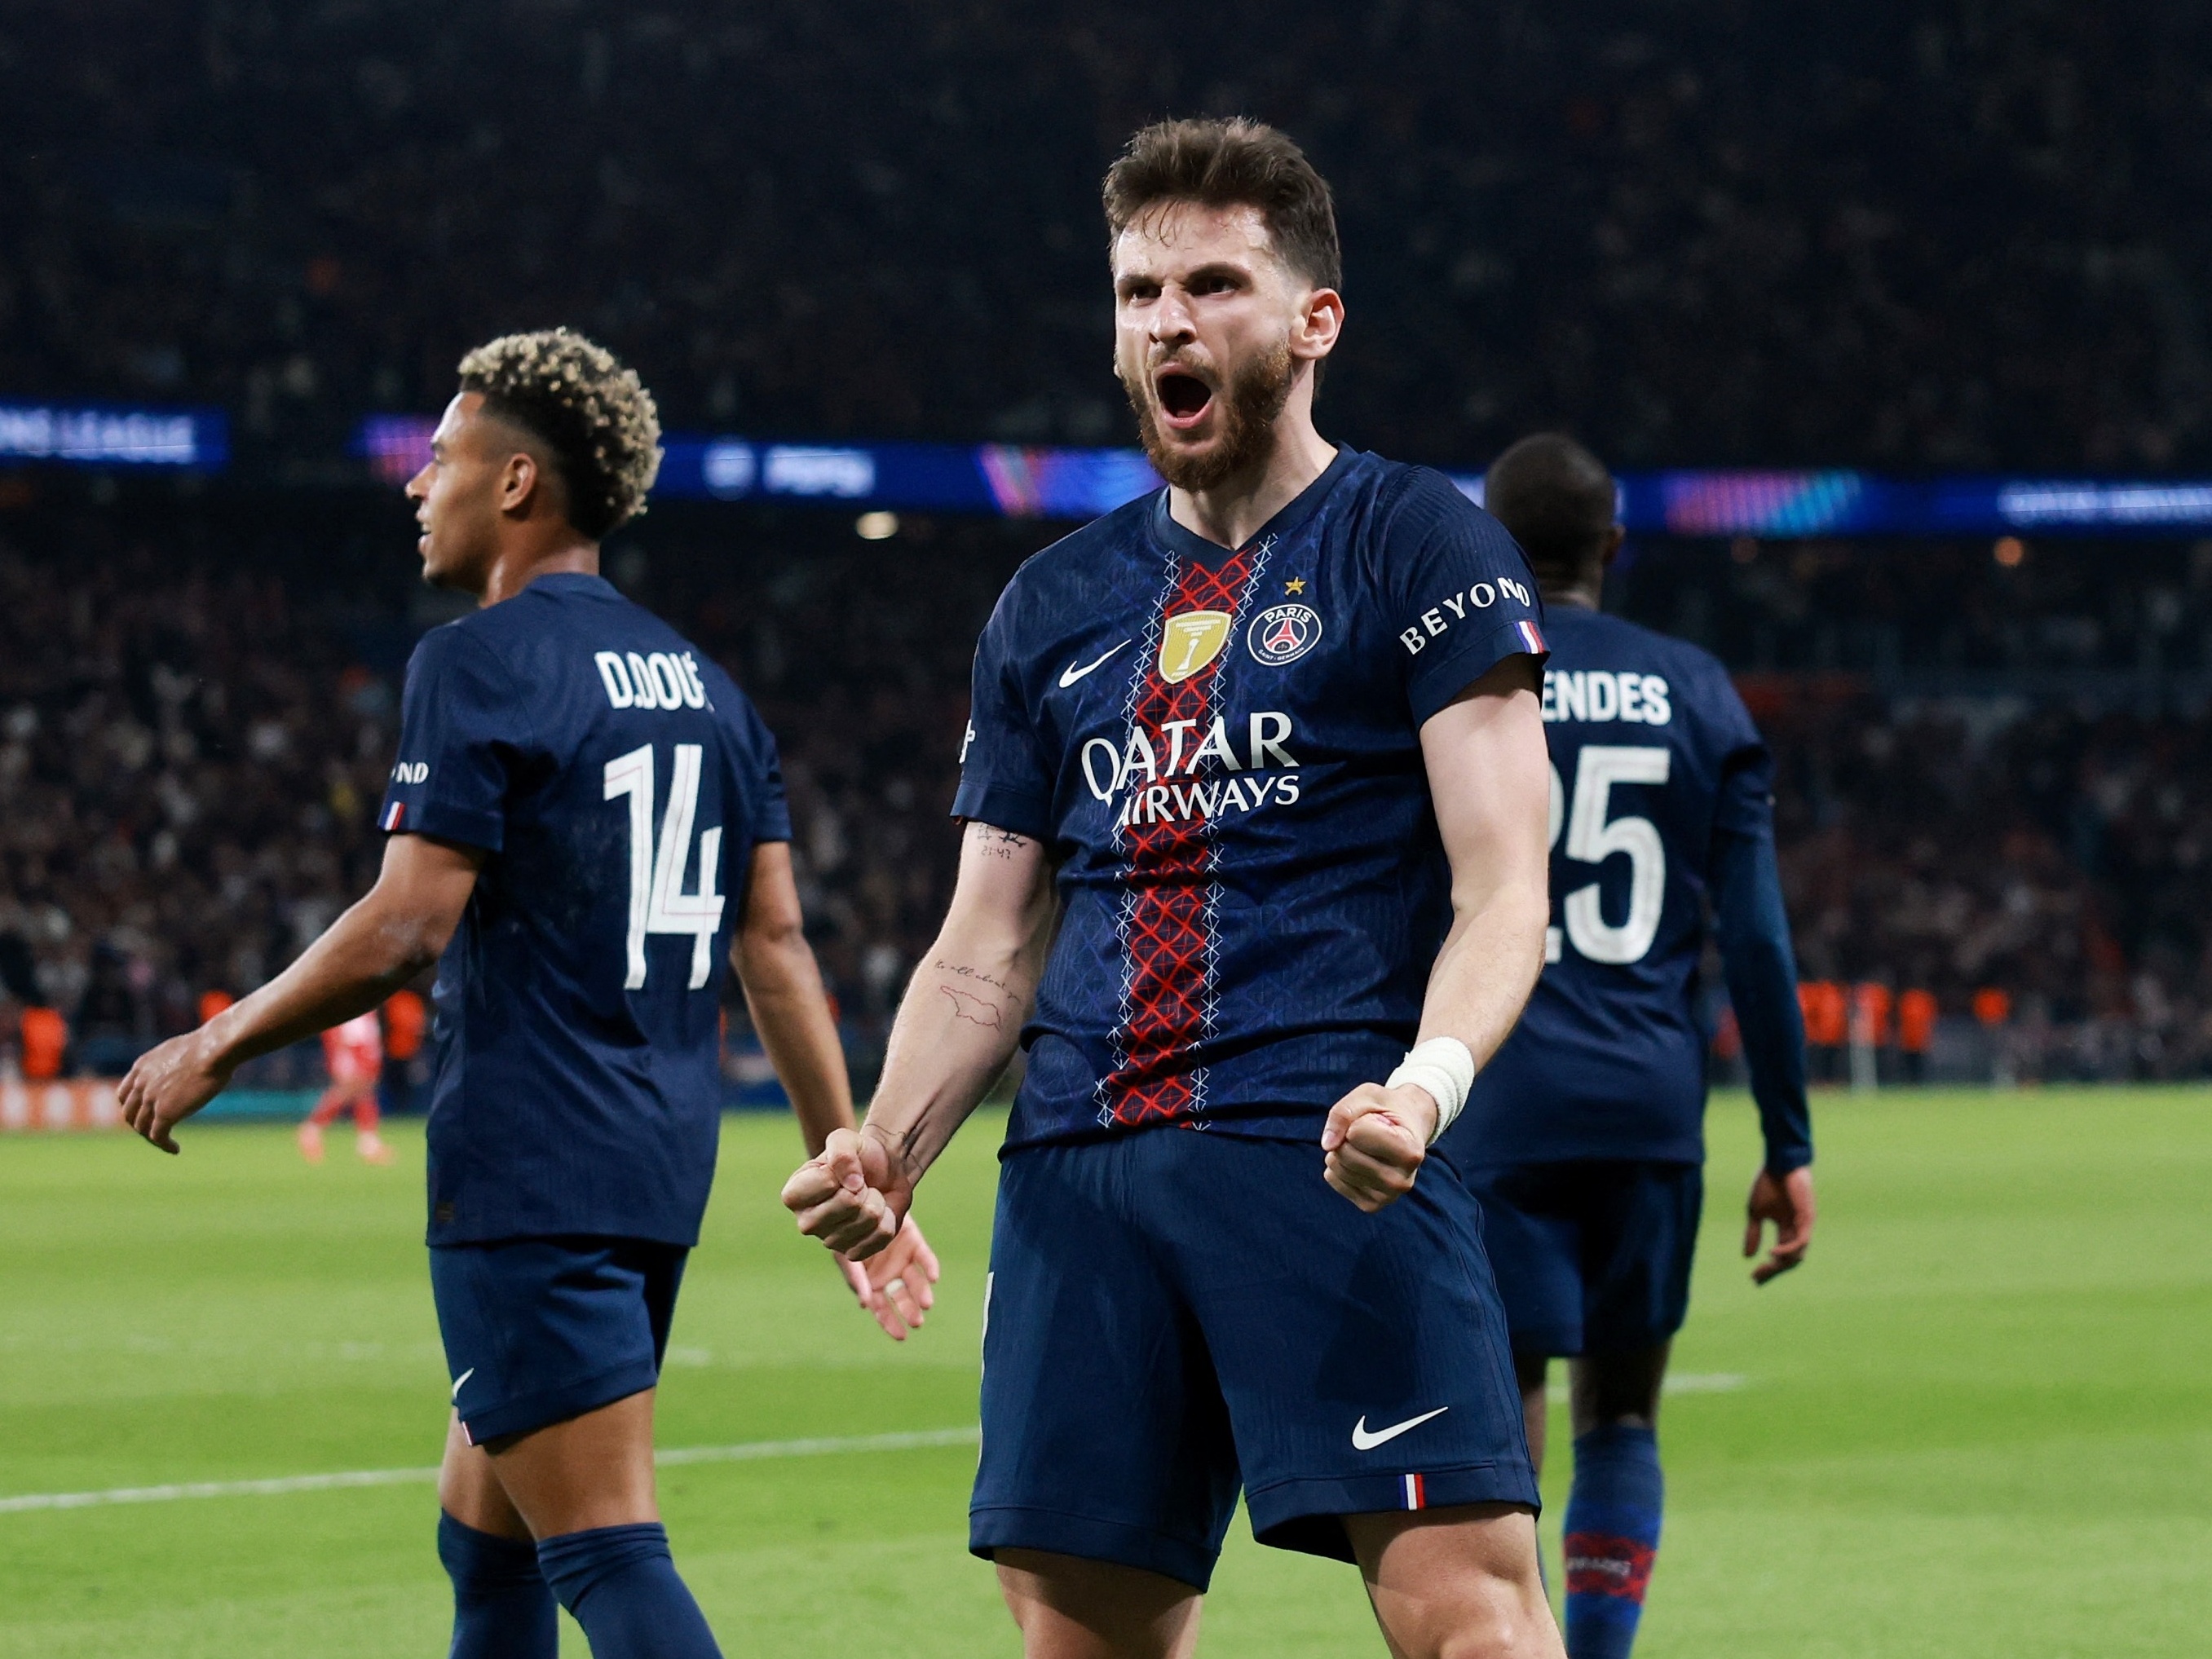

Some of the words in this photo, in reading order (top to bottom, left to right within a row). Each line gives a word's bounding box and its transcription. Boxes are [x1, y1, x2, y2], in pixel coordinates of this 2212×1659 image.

[1264, 607, 1312, 624] PARIS
[1398, 576, 1531, 655] BEYOND
[391, 761, 429, 785] ND
[1081, 711, 1300, 809] QATAR
[1111, 774, 1300, 832] AIRWAYS
[603, 743, 726, 991] 14
